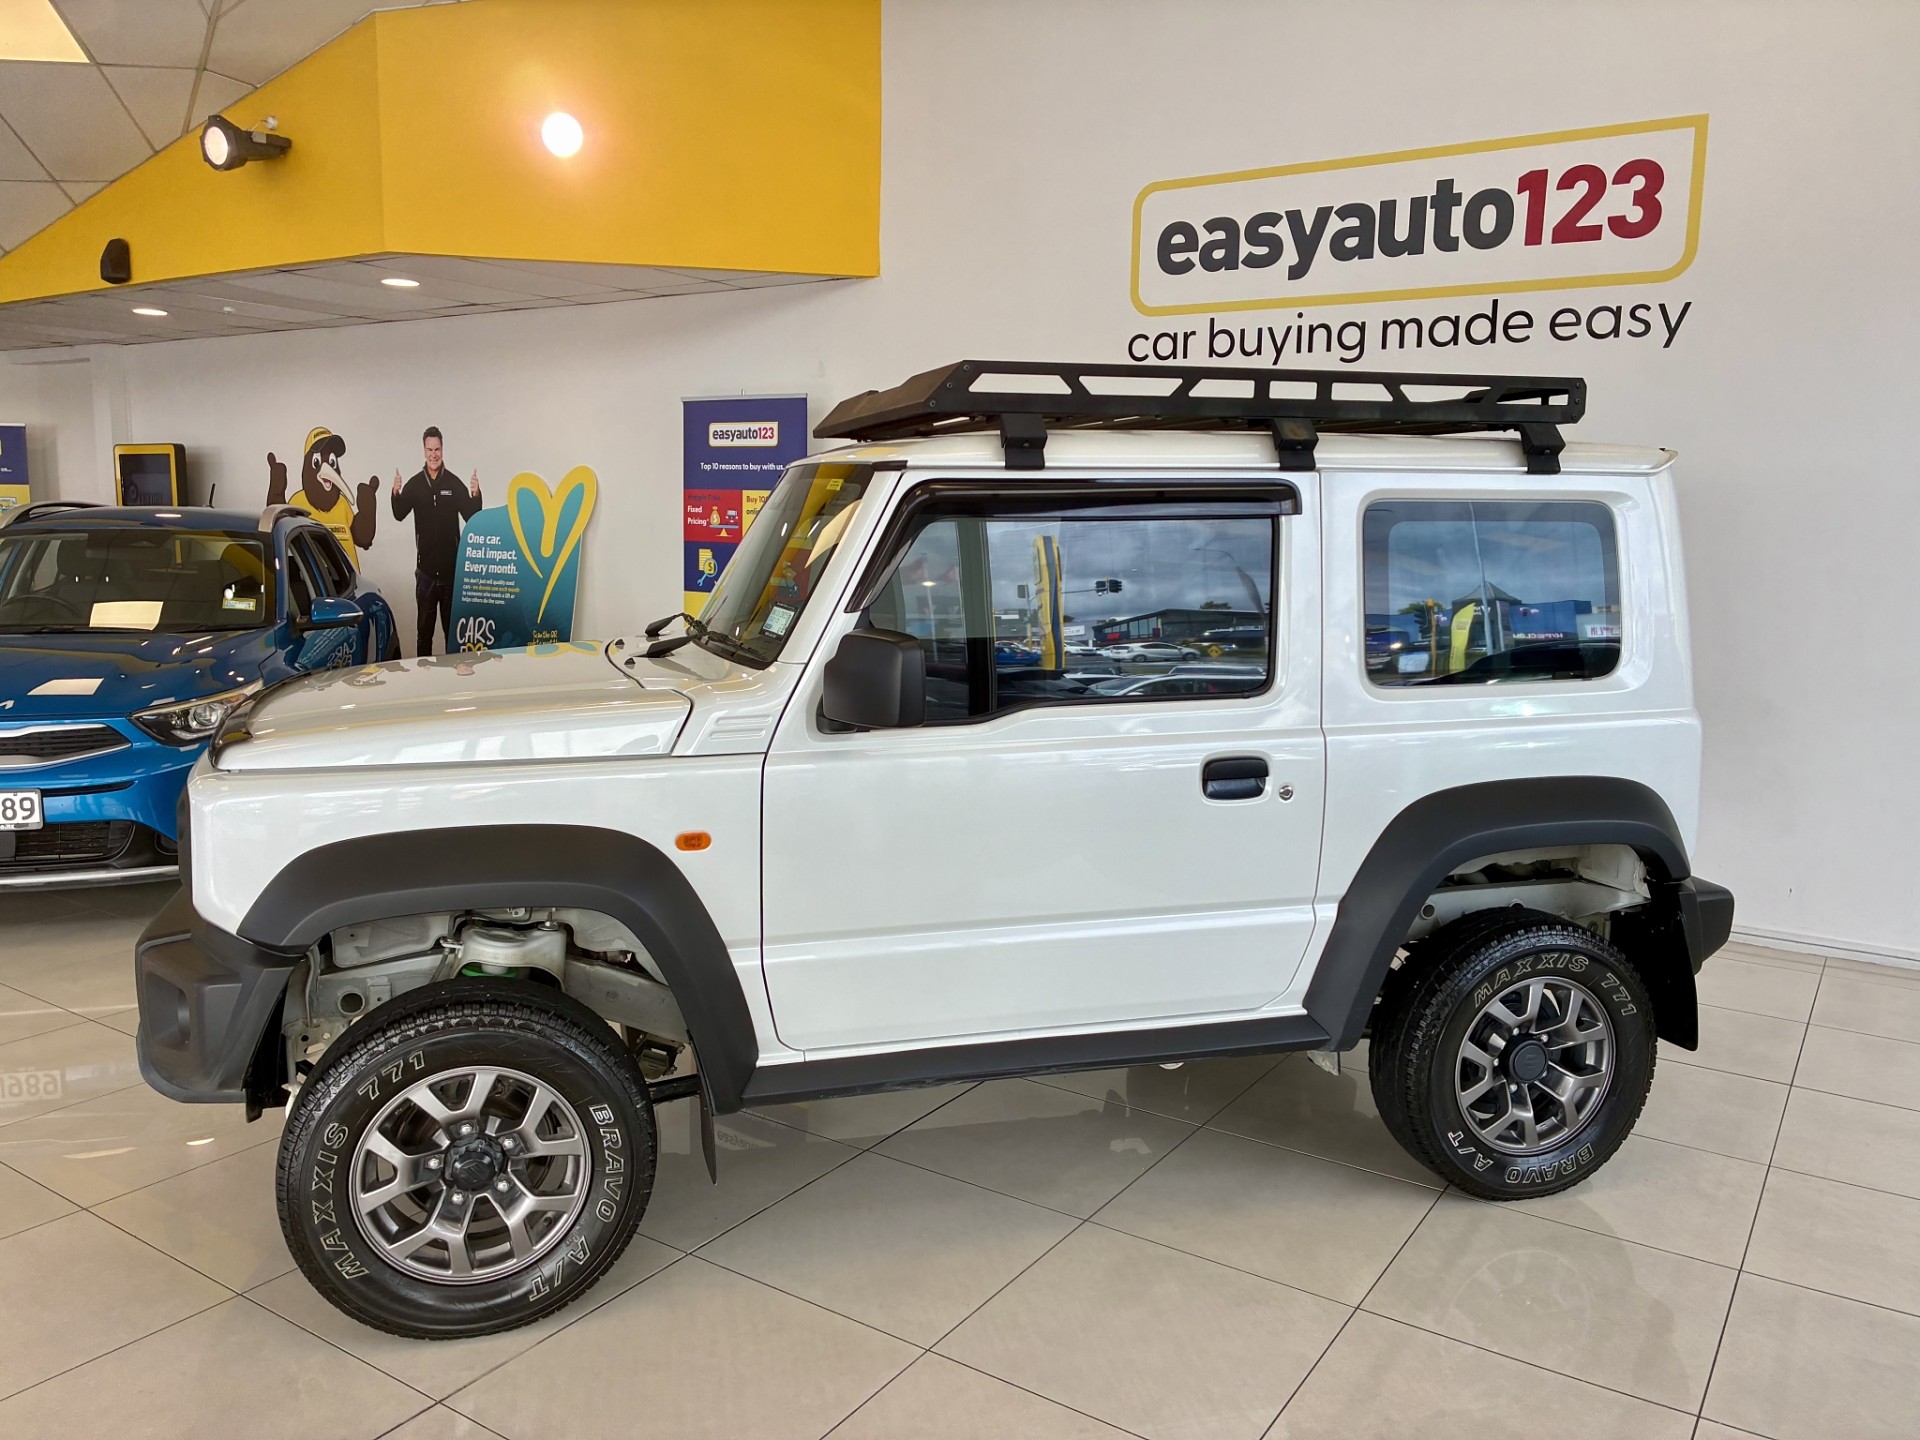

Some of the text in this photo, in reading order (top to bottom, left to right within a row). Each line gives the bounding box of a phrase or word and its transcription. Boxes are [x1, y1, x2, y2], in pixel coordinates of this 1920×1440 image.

[1157, 158, 1665, 281] easyauto123
[1128, 299, 1692, 366] car buying made easy
[712, 427, 774, 442] easyauto123
[700, 462, 711, 471] Top
[712, 462, 719, 470] 10
[719, 463, 741, 471] reasons
[742, 463, 749, 471] to
[749, 462, 761, 472] buy
[762, 463, 776, 471] with
[687, 505, 702, 513] Fixed
[746, 495, 758, 504] Buy
[467, 532, 501, 544] One car.
[466, 547, 518, 561] Real impact.
[464, 560, 518, 576] Every month.
[456, 616, 495, 645] CARS
[1474, 953, 1638, 1016] MAXXIS 771
[311, 1050, 426, 1280] MAXXIS 771
[1447, 1130, 1596, 1184] BRAVO A/T
[529, 1103, 624, 1302] BRAVO A/T
